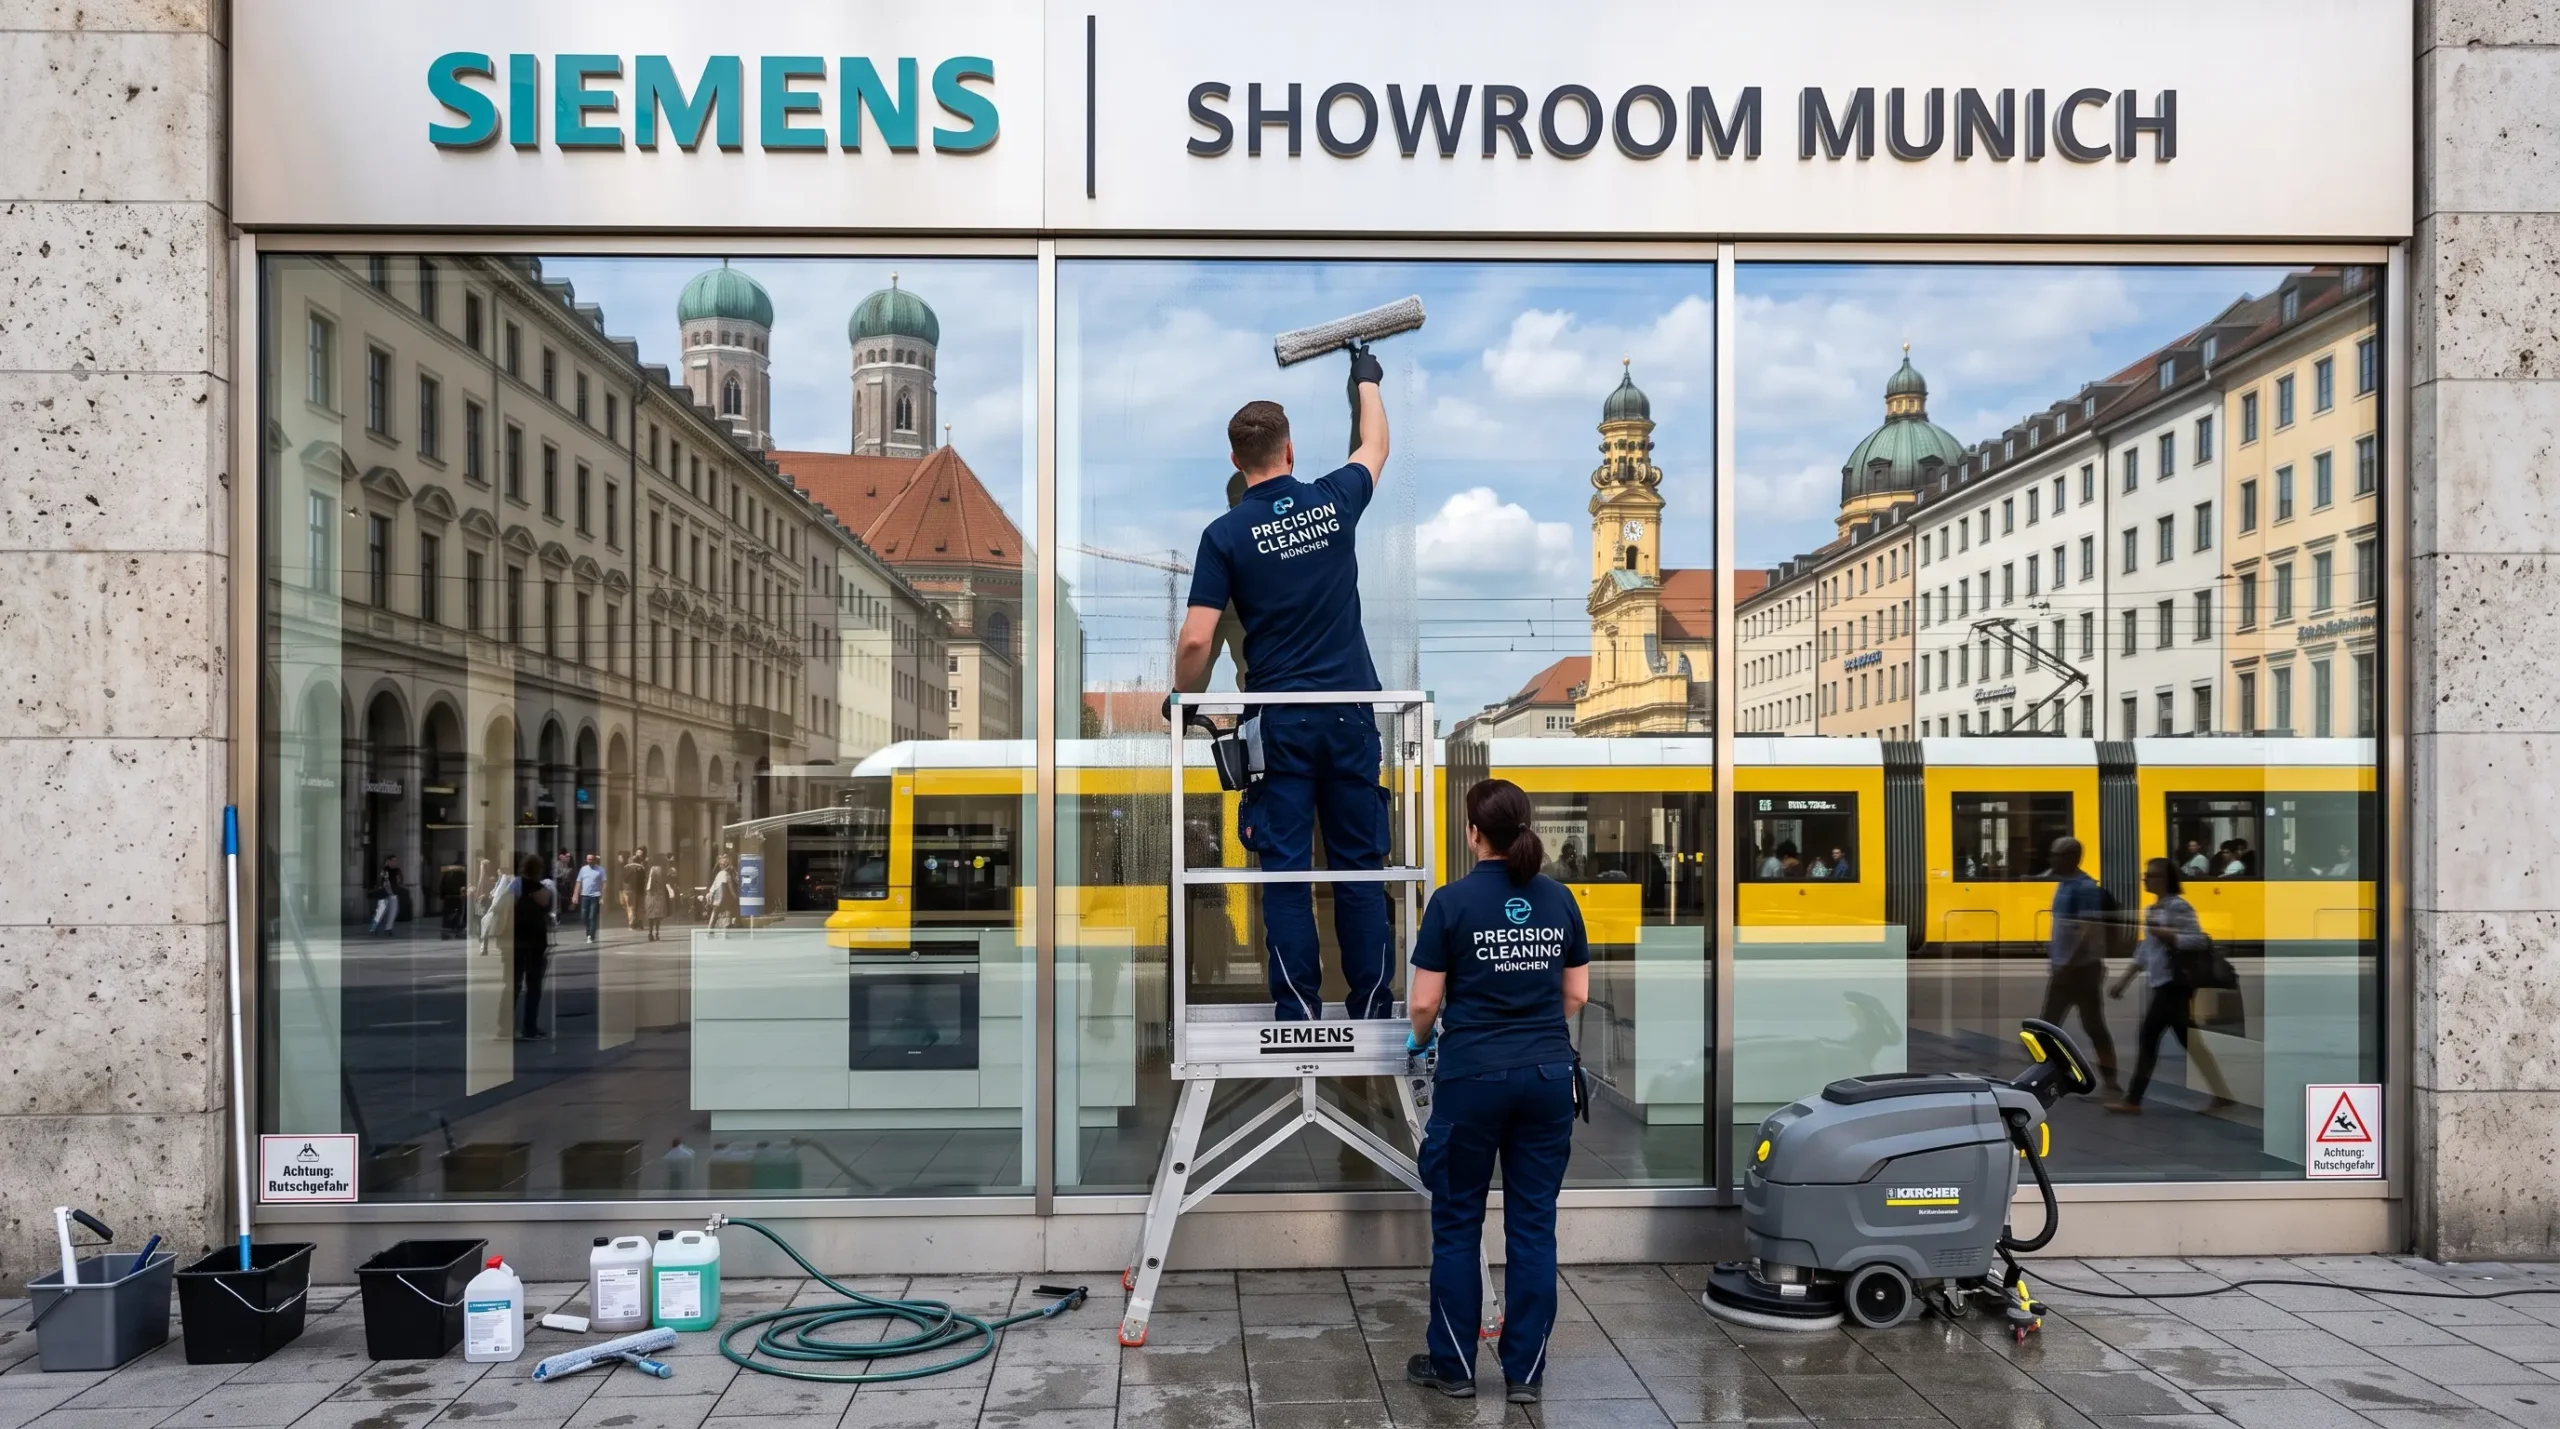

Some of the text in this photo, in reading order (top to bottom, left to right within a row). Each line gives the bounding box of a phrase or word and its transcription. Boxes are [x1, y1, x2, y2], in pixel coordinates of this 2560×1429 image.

[427, 51, 1001, 154] SIEMENS
[1185, 81, 2179, 162] SHOWROOM MUNICH
[1251, 502, 1336, 540] PRECISION
[1257, 518, 1340, 554] CLEANING
[1473, 928, 1564, 945] PRECISION
[1476, 944, 1561, 960] CLEANING
[1494, 961, 1549, 972] MÜNCHEN
[1260, 1027, 1354, 1044] SIEMENS
[2323, 1148, 2365, 1158] Achtung:
[283, 1165, 334, 1179] Achtung:
[2314, 1160, 2375, 1171] Rutschgefahr
[269, 1180, 349, 1194] Rutschgefahr
